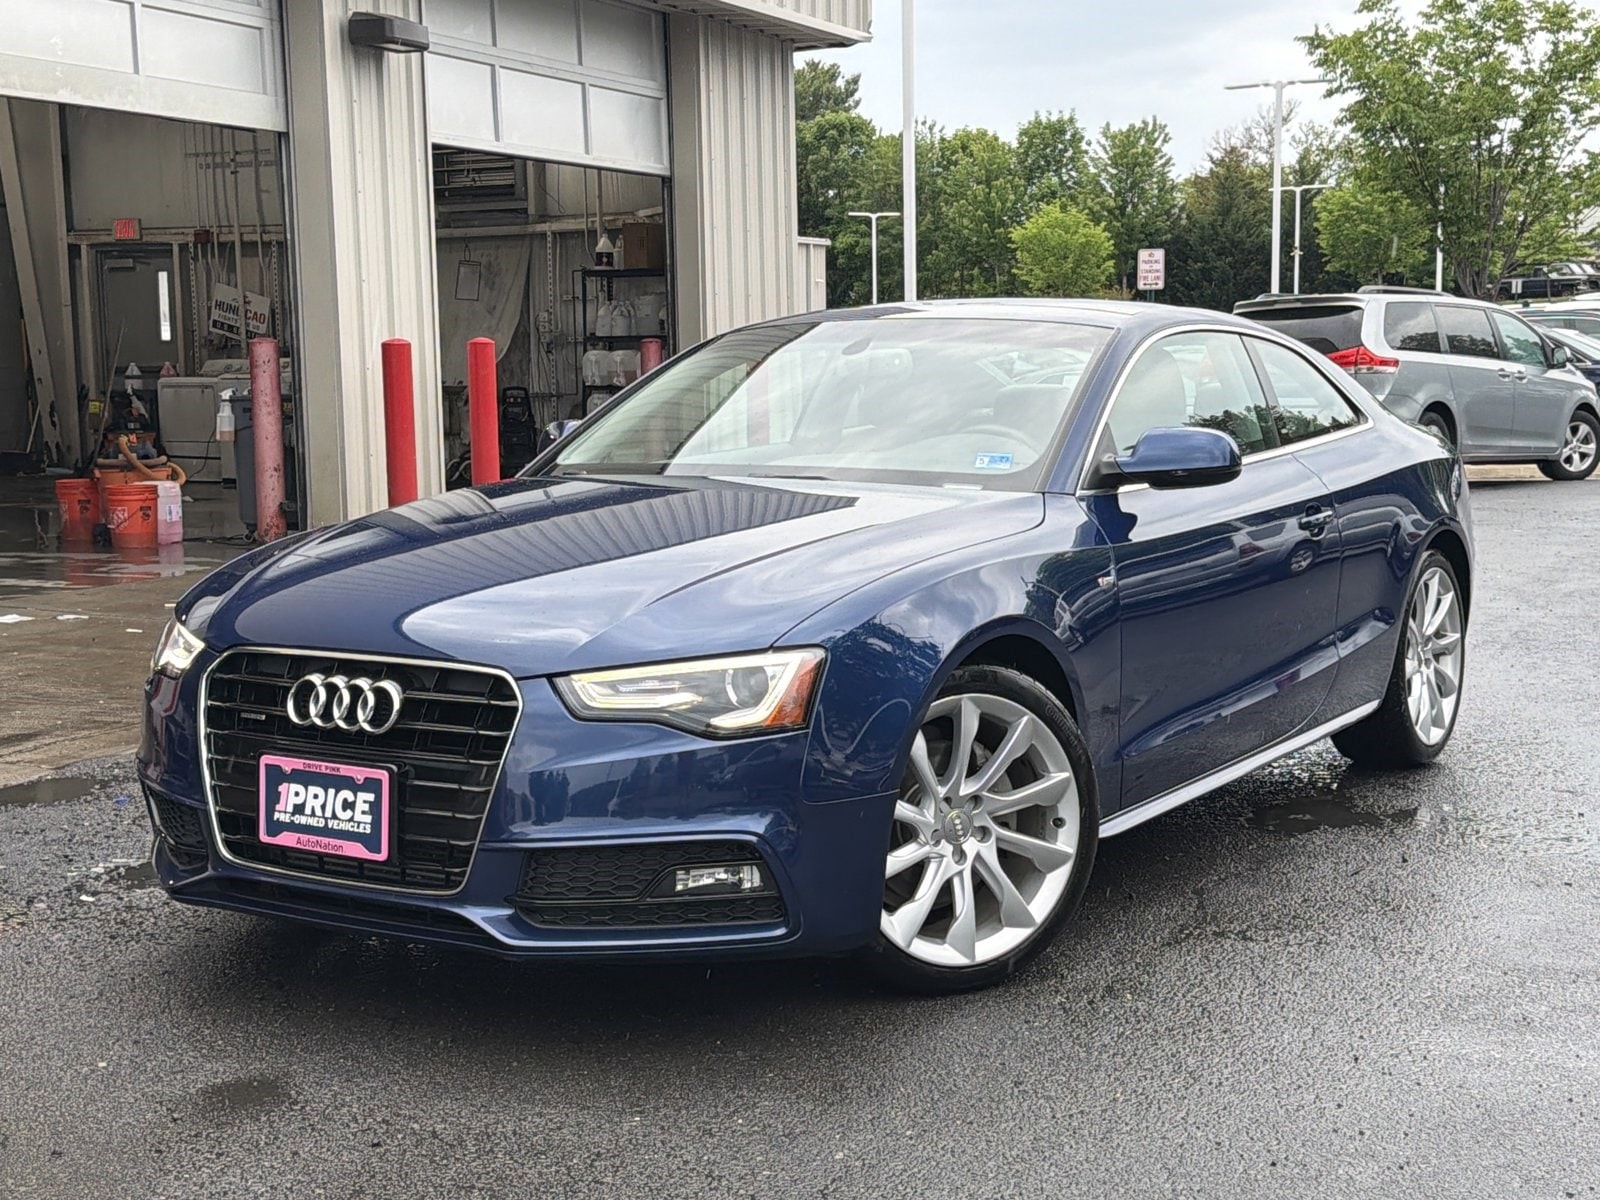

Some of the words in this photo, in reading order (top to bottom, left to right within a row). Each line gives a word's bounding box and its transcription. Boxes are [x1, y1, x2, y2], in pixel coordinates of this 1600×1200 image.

[302, 762, 323, 772] DRIVE
[324, 765, 342, 774] PINK
[275, 782, 376, 824] 1PRICE
[273, 811, 326, 828] PRE-OWNED
[327, 818, 372, 834] VEHICLES
[295, 836, 345, 854] AutoNation
